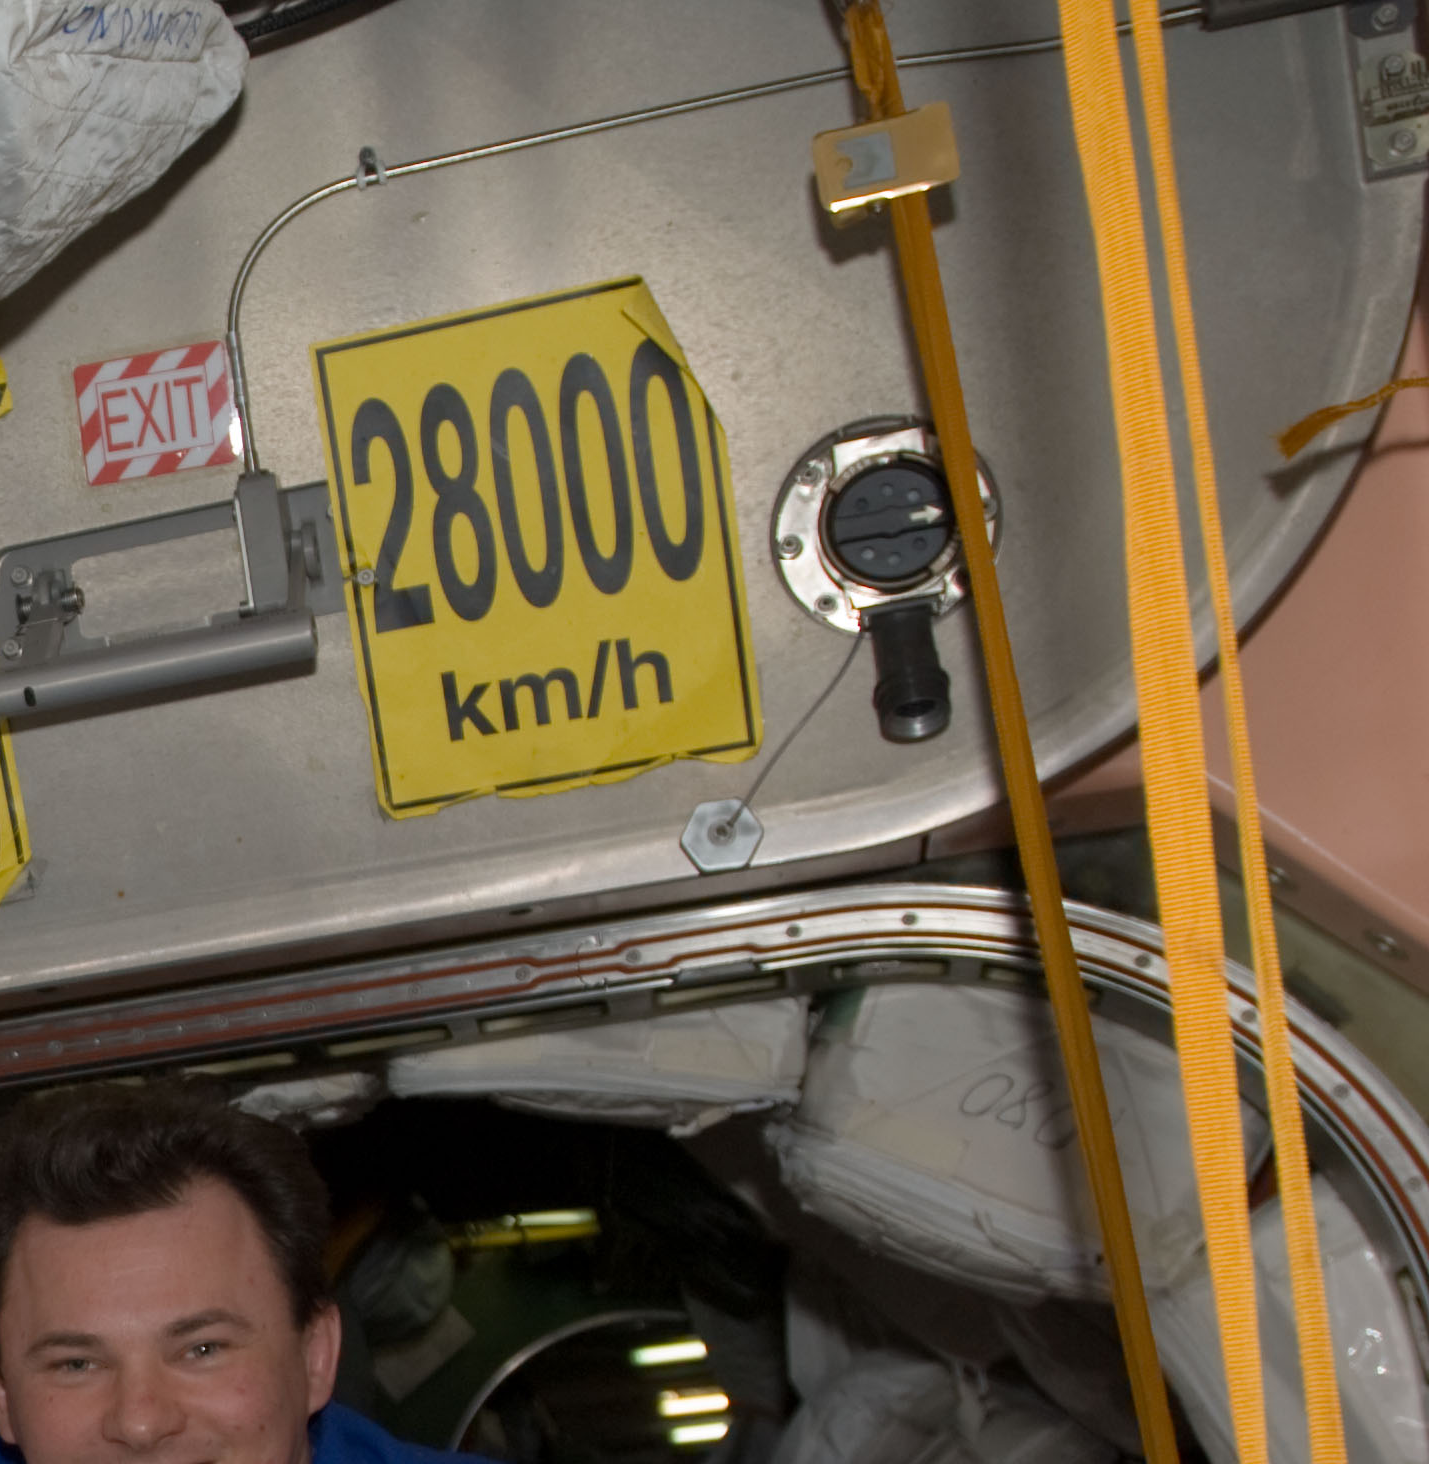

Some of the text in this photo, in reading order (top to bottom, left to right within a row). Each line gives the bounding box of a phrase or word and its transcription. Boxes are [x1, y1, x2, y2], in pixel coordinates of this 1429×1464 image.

[100, 374, 205, 451] EXIT
[351, 337, 705, 634] 28000
[441, 638, 674, 741] km/h
